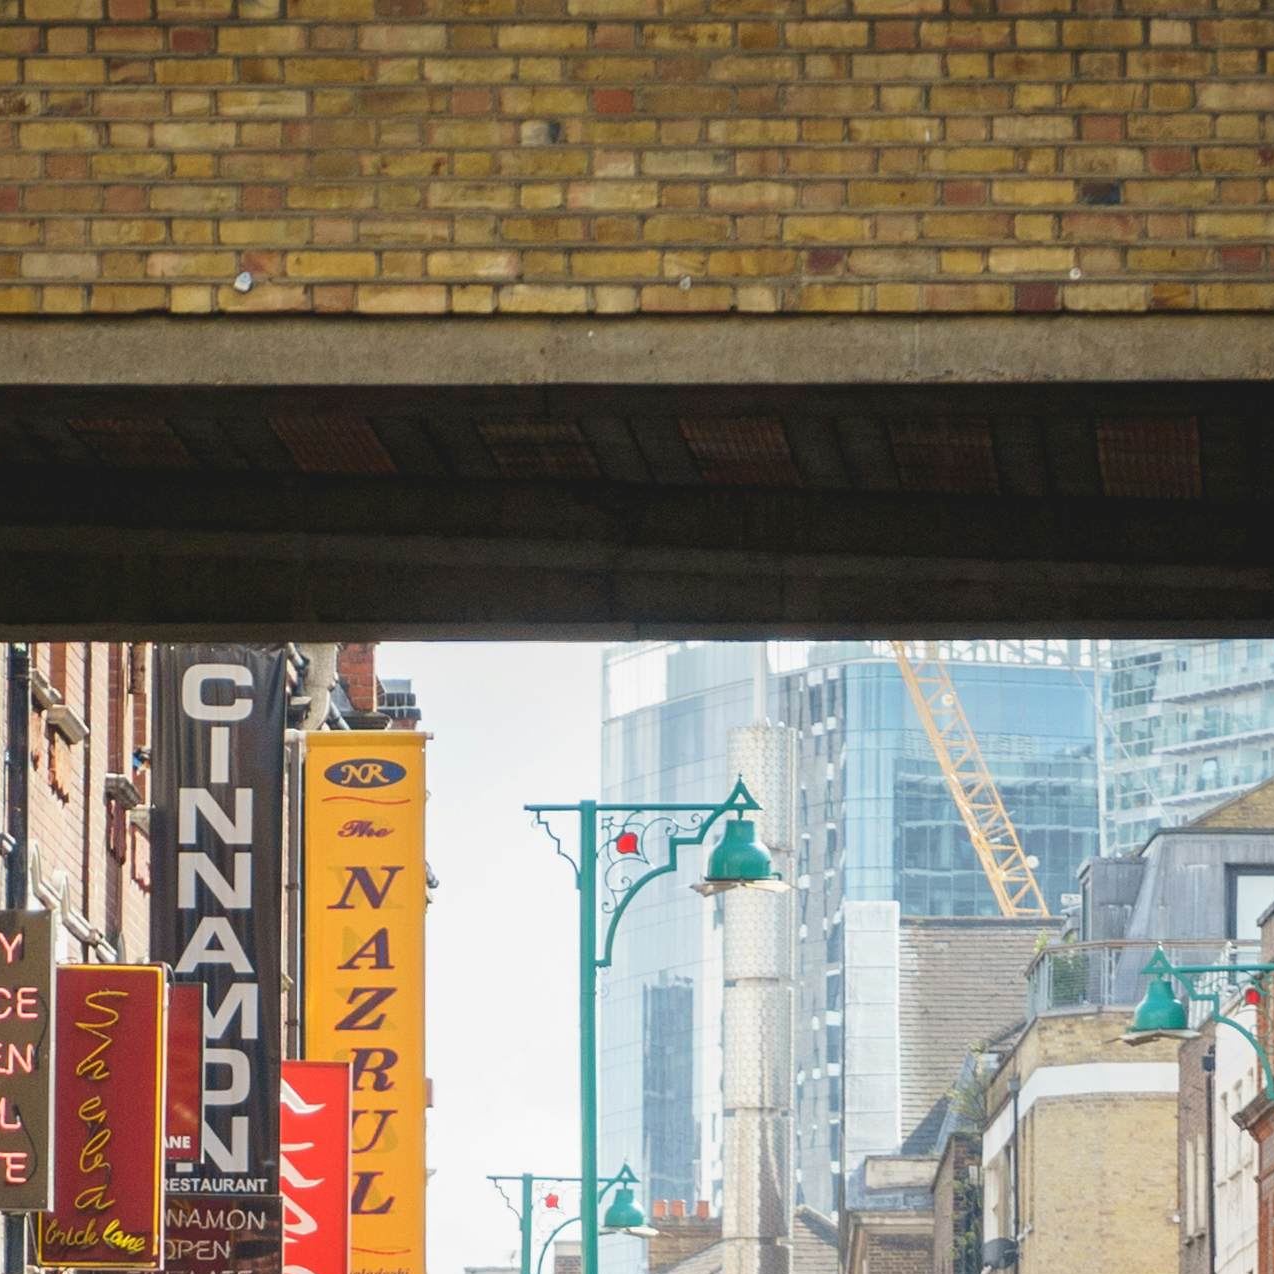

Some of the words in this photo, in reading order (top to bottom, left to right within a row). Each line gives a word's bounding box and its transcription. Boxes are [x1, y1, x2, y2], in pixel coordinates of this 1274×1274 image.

[174, 664, 260, 1173] CINNAMON
[337, 819, 395, 838] The
[326, 866, 405, 1215] NAZRUL
